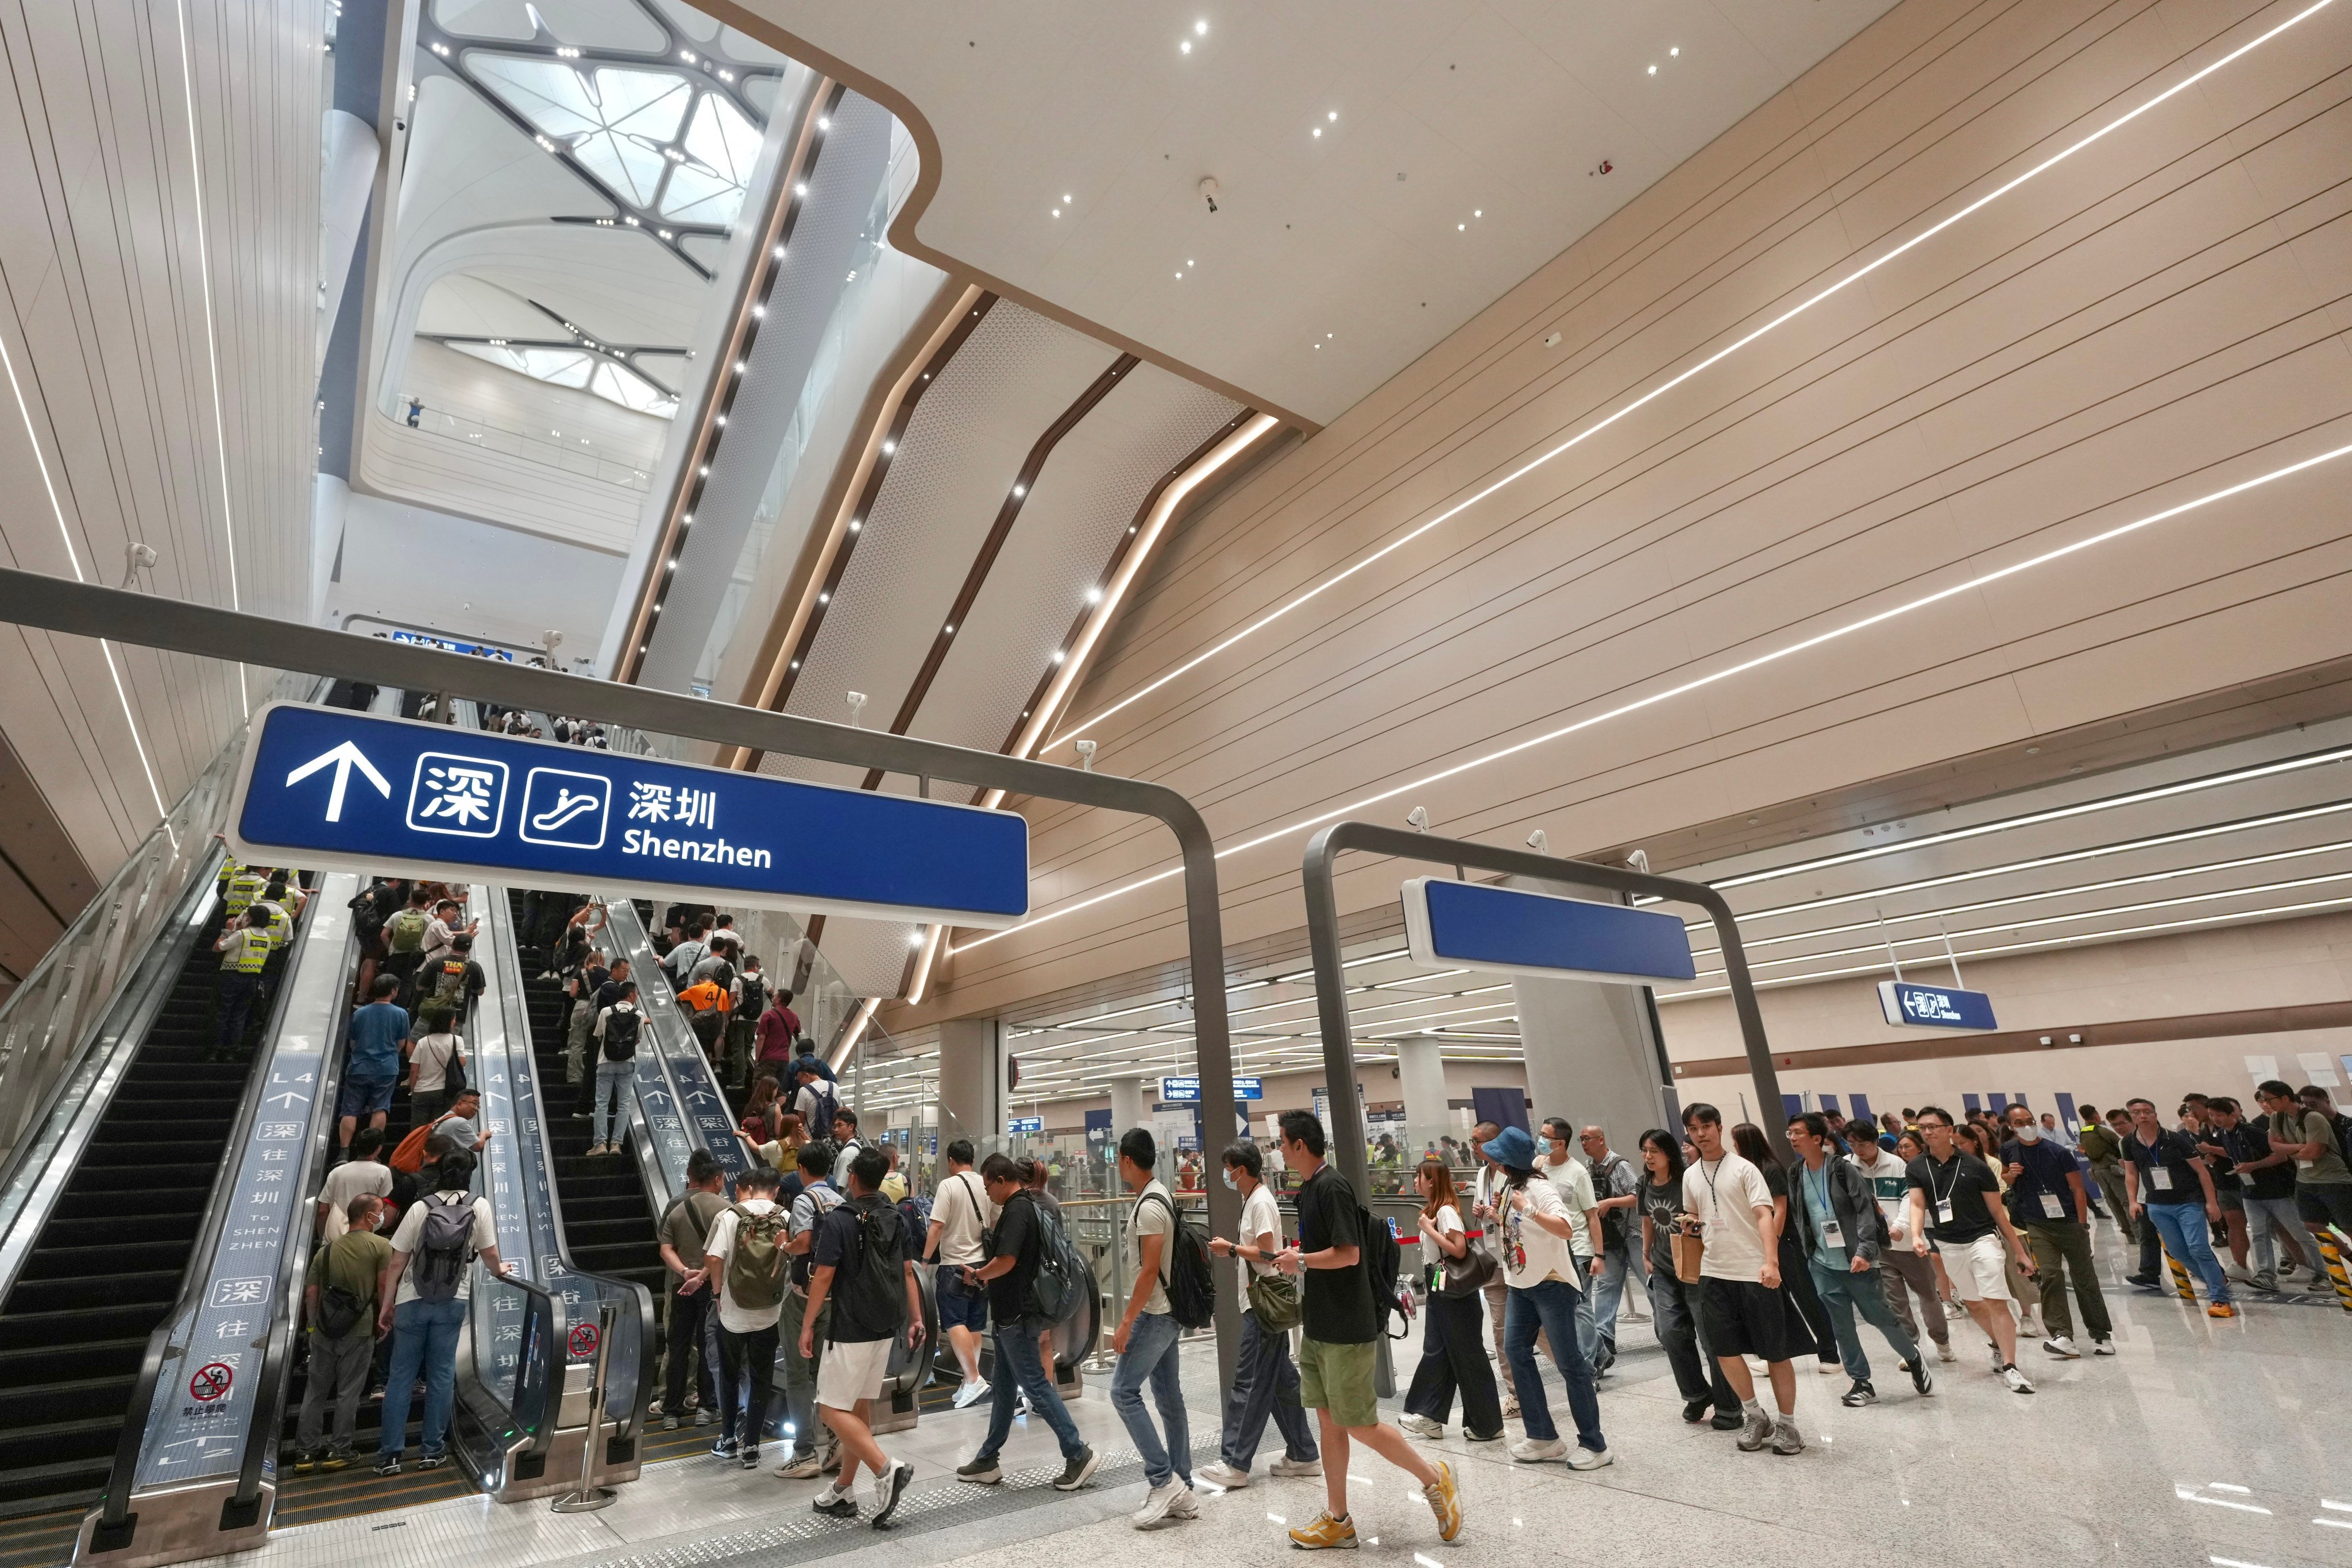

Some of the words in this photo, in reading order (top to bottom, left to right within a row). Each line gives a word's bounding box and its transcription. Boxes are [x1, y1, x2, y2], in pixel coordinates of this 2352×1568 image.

[420, 767, 493, 826] 深
[628, 781, 716, 830] 深圳
[622, 829, 771, 868] Shenzhen
[705, 991, 715, 1003] 4
[1941, 1010, 1961, 1020] Shenzhen
[273, 1072, 314, 1083] L4
[656, 1118, 682, 1129] 深
[263, 1124, 297, 1138] 深
[250, 1149, 288, 1204] 往深圳
[233, 1227, 280, 1236] SHEN
[229, 1241, 277, 1250] ZHEN
[219, 1280, 262, 1303] 深
[182, 1403, 226, 1418] 禁止攀爬
